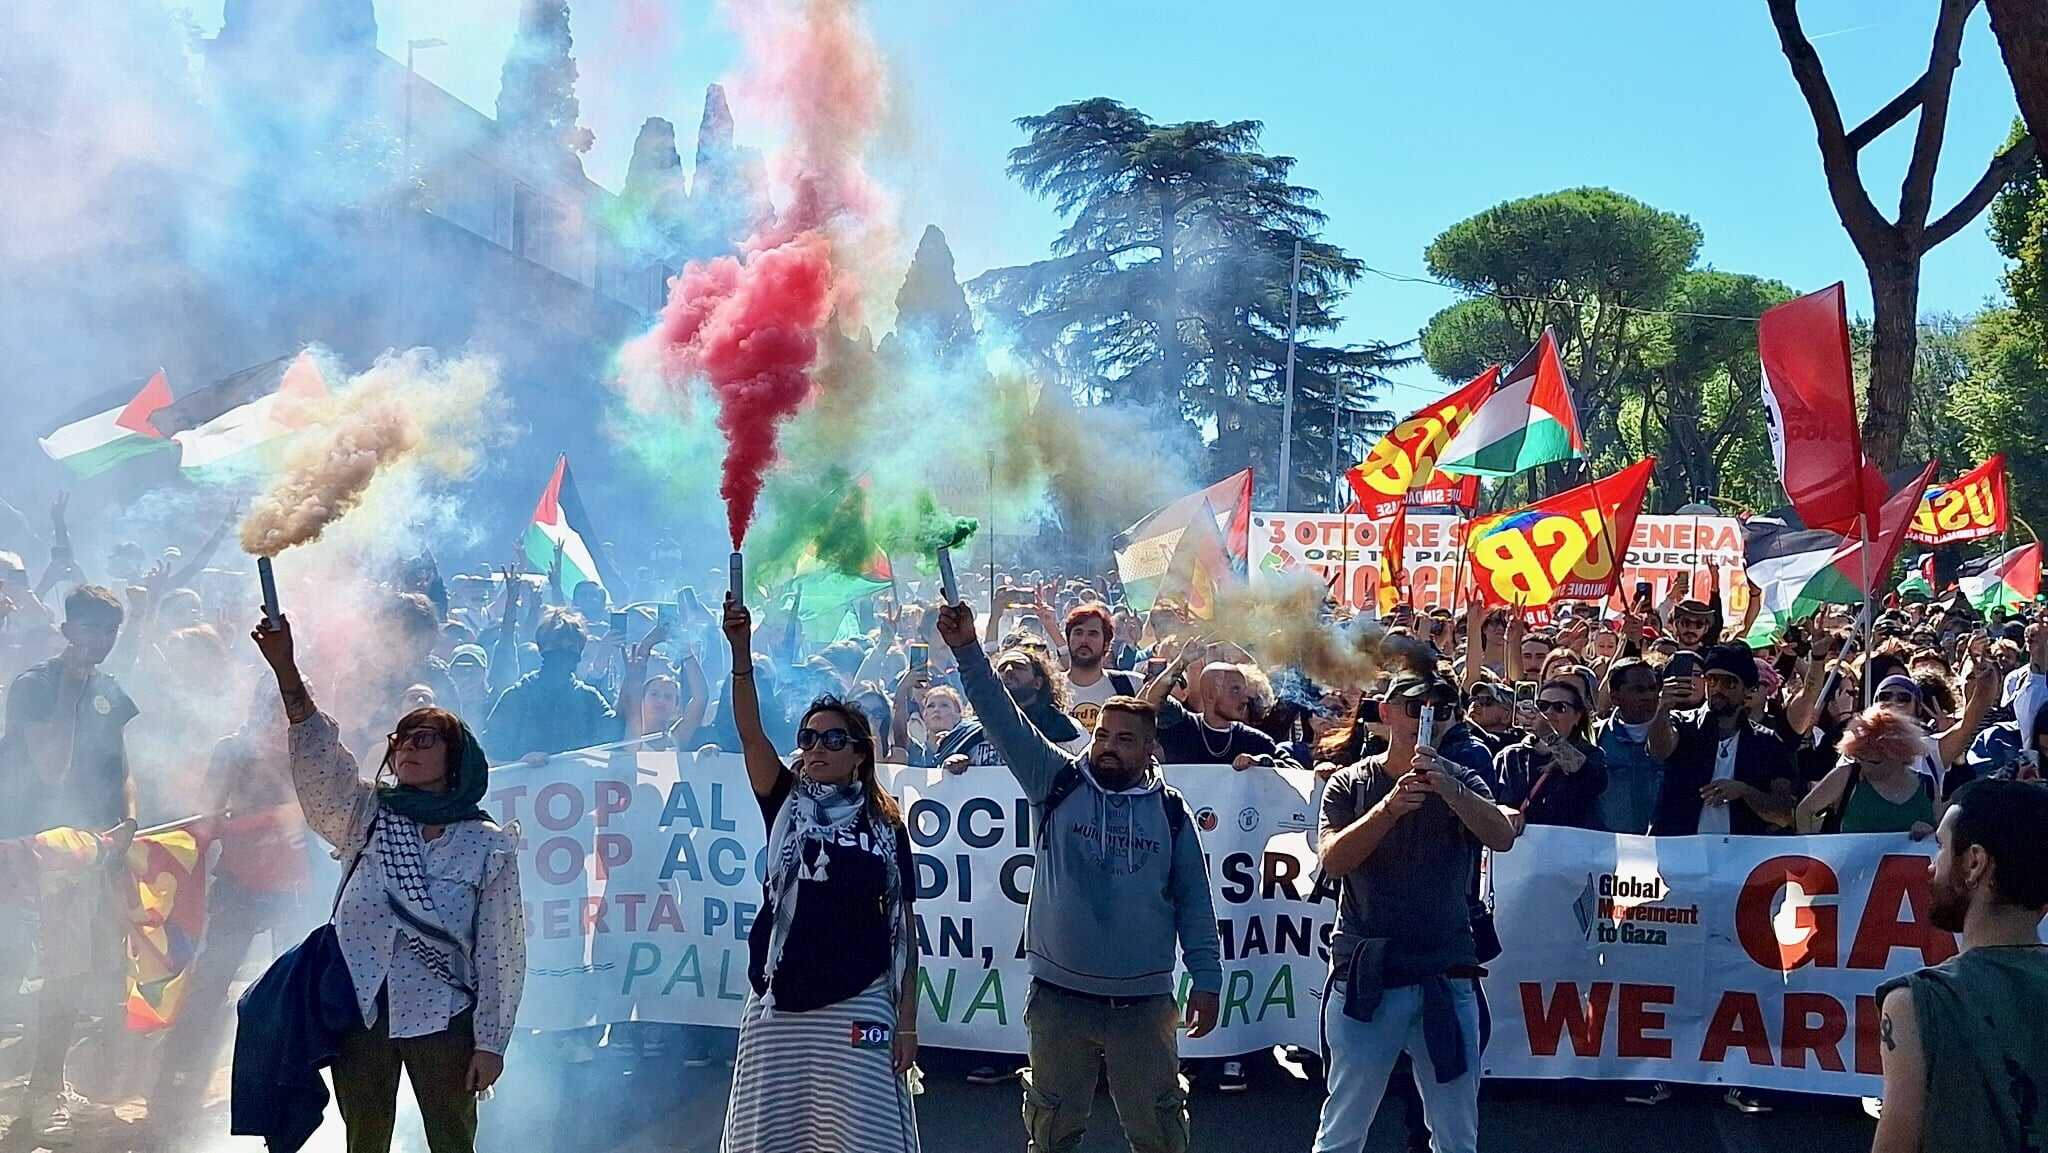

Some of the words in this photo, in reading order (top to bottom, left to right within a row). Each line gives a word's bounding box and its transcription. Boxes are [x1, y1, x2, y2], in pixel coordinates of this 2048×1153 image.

[1269, 521, 1286, 544] 3
[1294, 521, 1441, 547] OTTORE
[1304, 548, 1360, 562] ORE
[1415, 550, 1459, 562] PIA
[490, 781, 633, 833] TOP
[658, 781, 736, 833] AL
[1599, 873, 1661, 899] Global
[703, 896, 758, 941] PE
[1597, 897, 1699, 925] Movement
[1735, 854, 1960, 971] GA
[1597, 921, 1617, 943] to
[1620, 922, 1667, 945] Gaza
[1519, 982, 1676, 1059] WE
